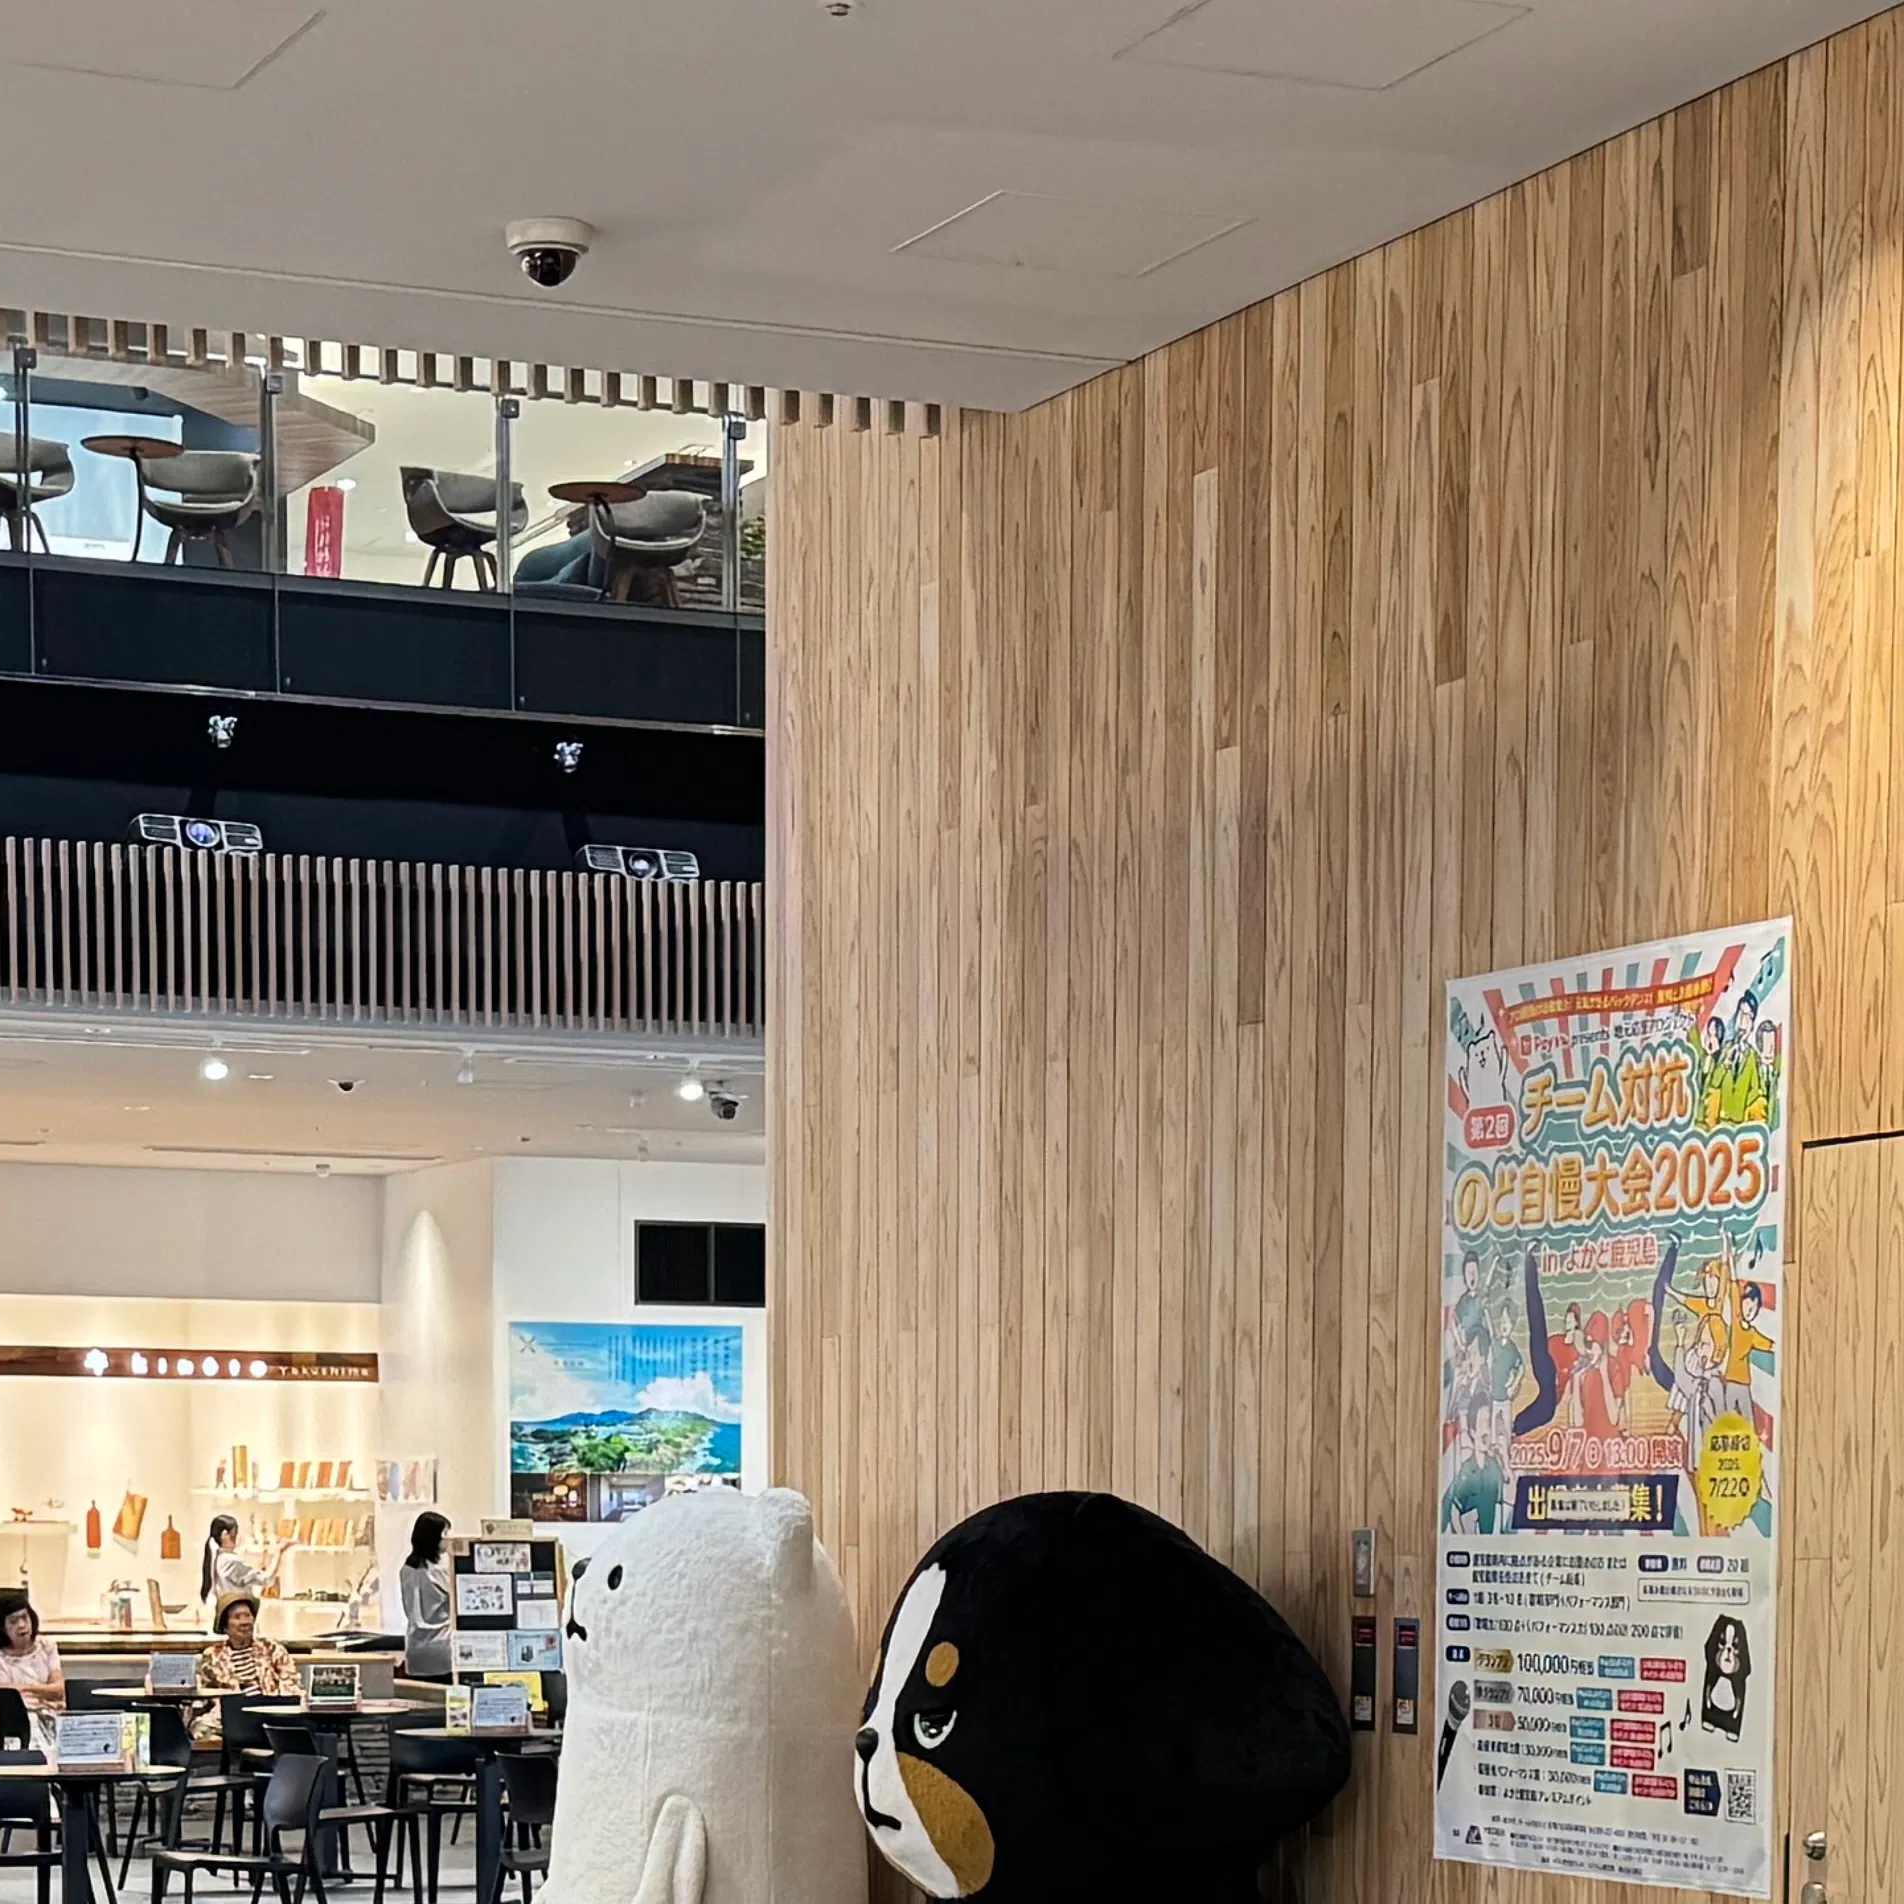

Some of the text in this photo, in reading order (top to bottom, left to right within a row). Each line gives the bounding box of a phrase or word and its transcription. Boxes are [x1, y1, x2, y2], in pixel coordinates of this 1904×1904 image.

[1521, 1052, 1690, 1137] チーム対抗
[1470, 1113, 1511, 1141] 第2回
[1457, 1138, 1763, 1228] のど自慢大会2025
[1565, 1234, 1658, 1271] よかど鹿児島
